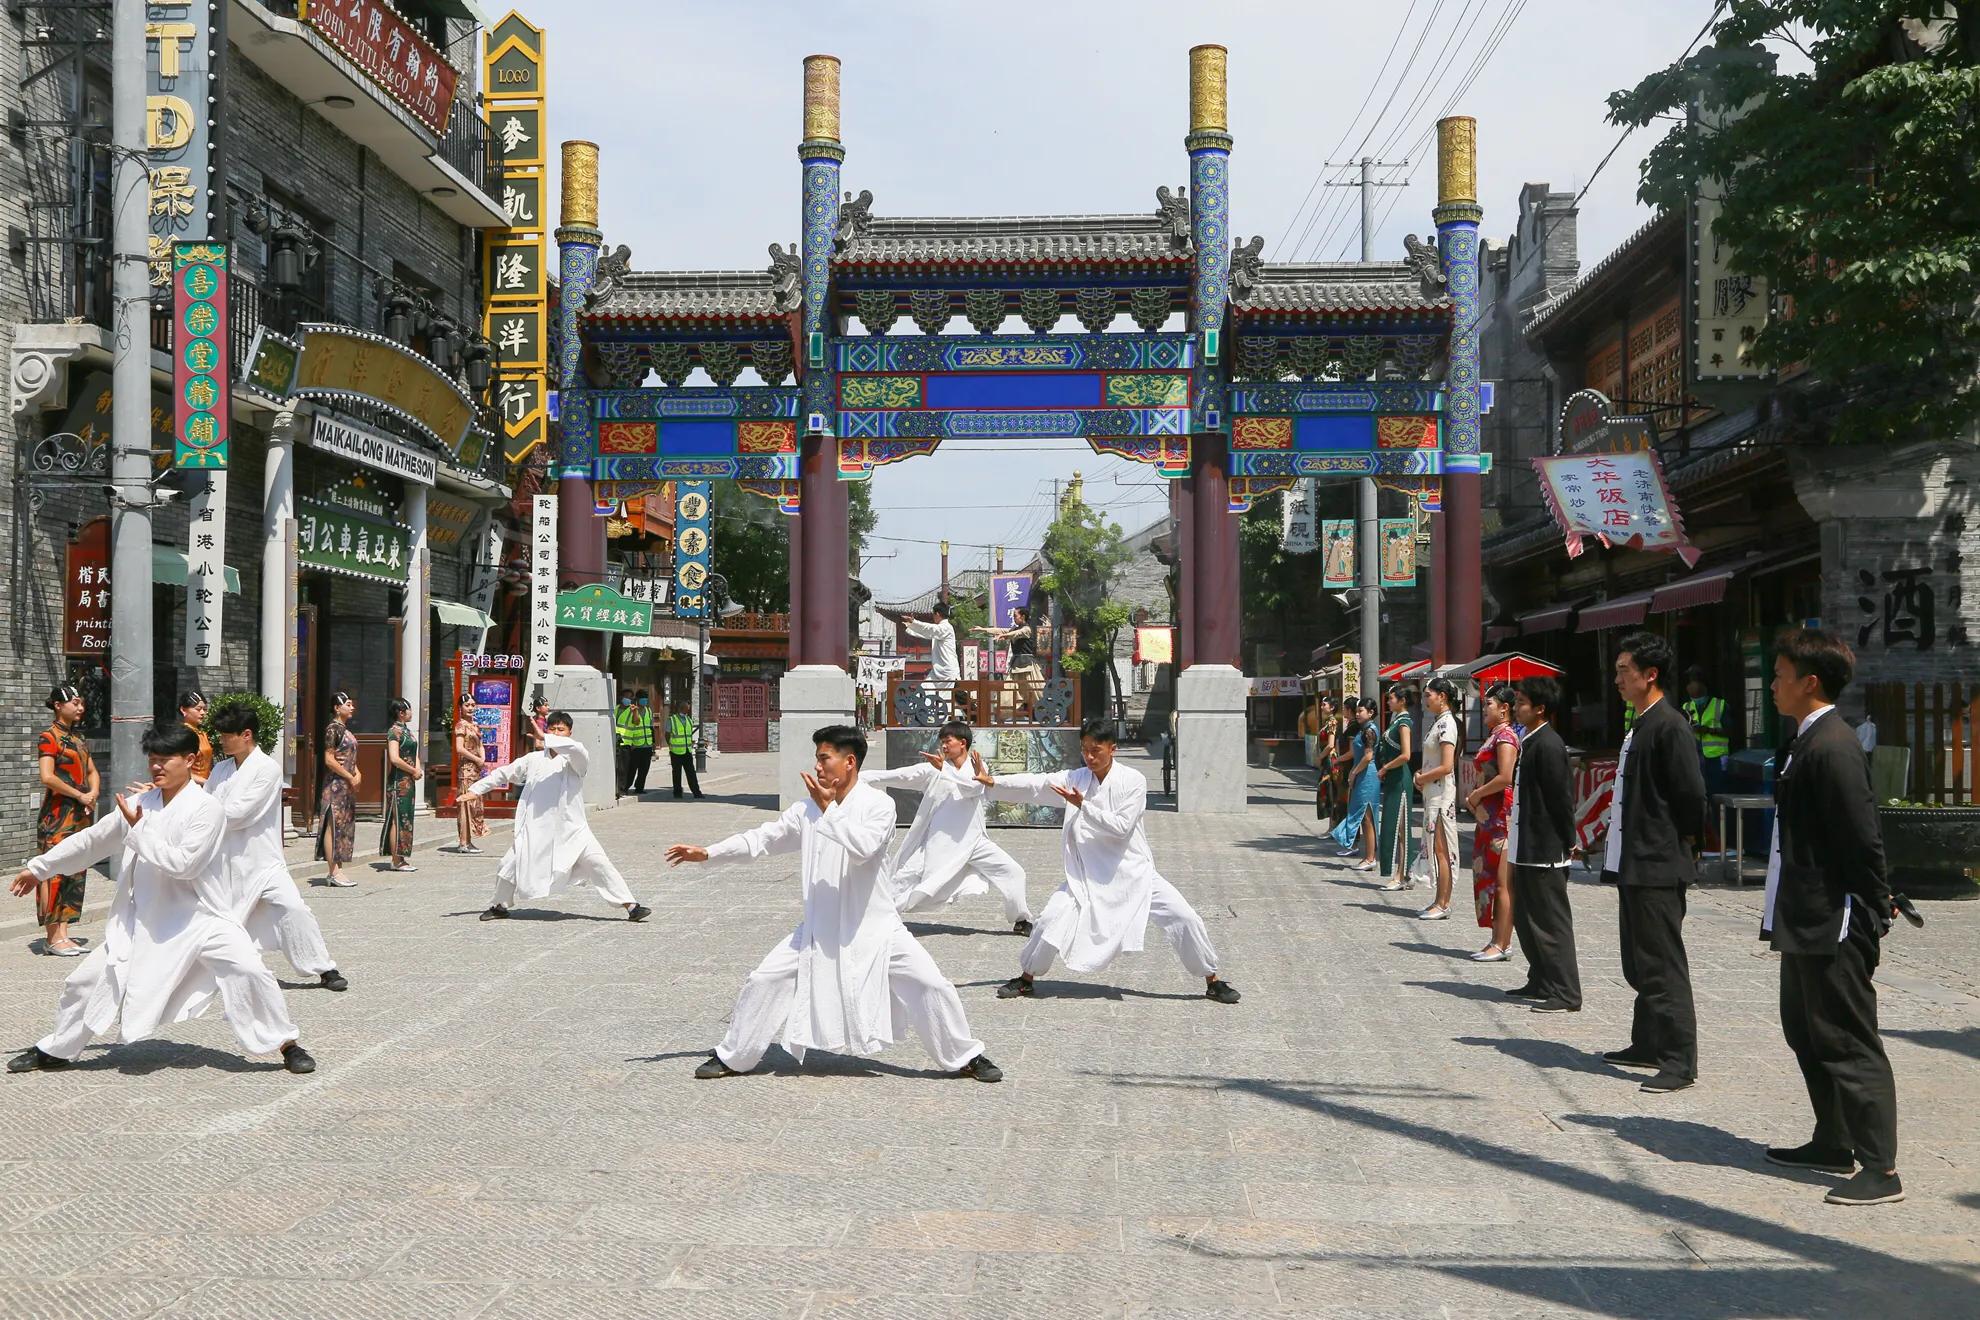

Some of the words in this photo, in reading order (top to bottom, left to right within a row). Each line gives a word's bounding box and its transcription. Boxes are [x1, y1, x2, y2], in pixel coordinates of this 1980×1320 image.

[317, 4, 347, 39] JOHN
[498, 69, 530, 84] LOGO
[497, 115, 533, 421] 麥凱隆洋行
[315, 420, 384, 463] MAIKAILONG
[385, 445, 435, 480] MATHESON
[1586, 458, 1632, 526] 大华饭店
[1857, 566, 1936, 650] 酒
